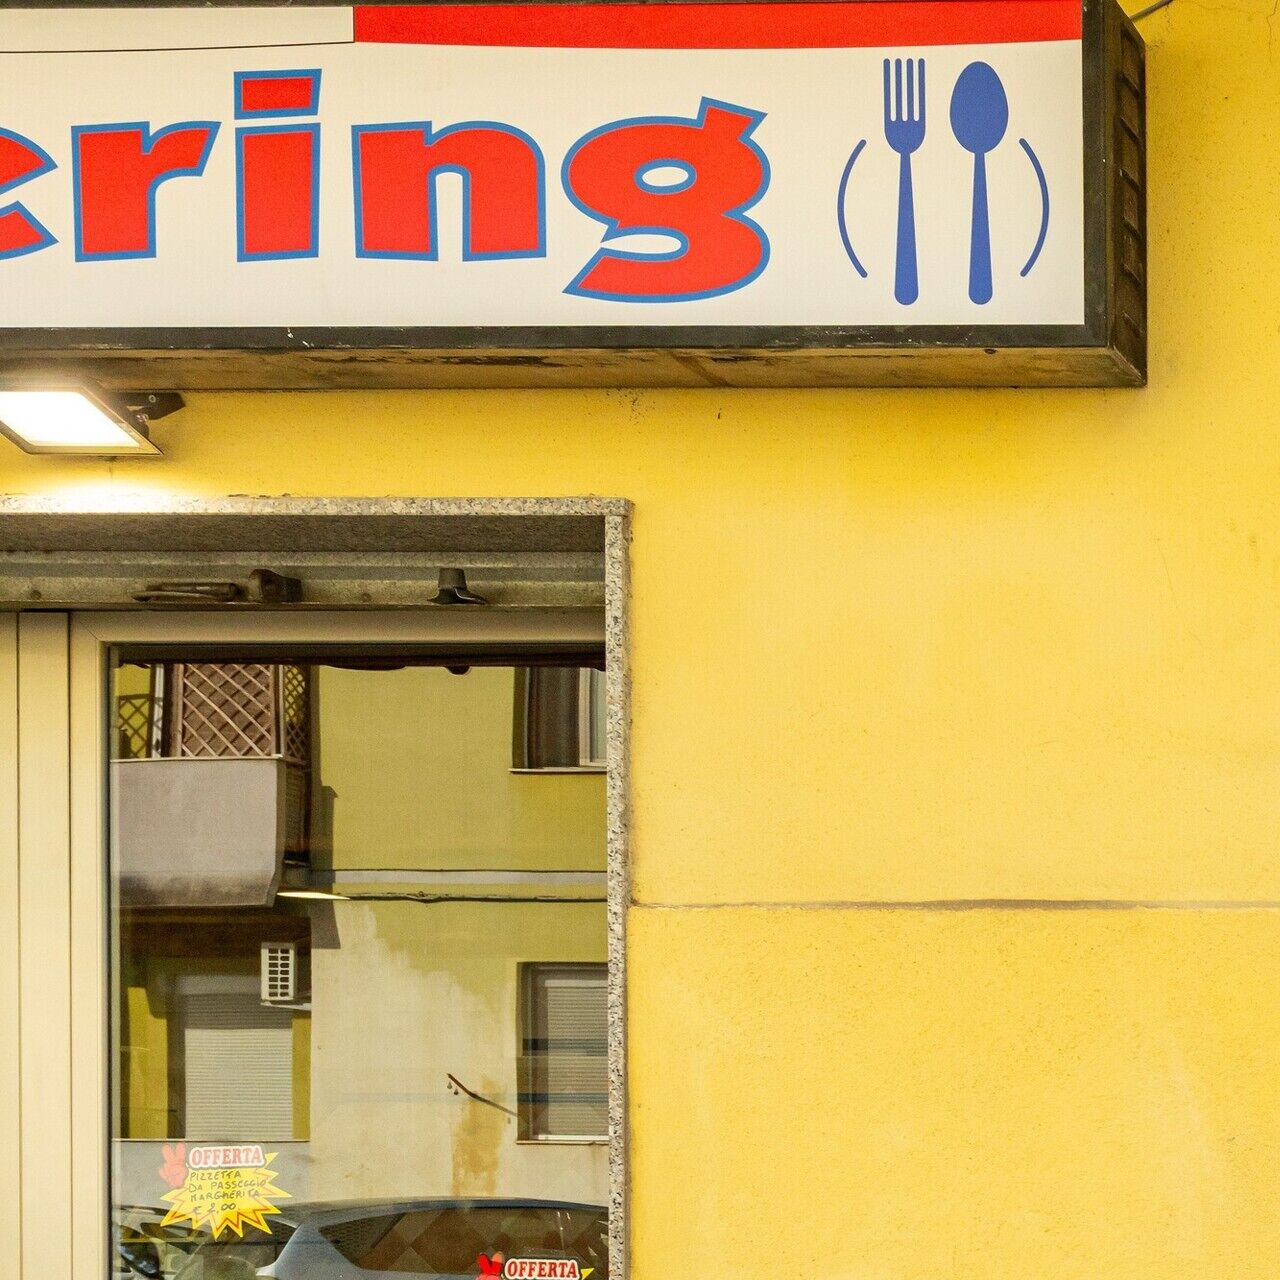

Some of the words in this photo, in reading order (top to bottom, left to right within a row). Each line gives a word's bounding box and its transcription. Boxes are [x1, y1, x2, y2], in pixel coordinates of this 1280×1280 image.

[192, 1147, 263, 1166] OFFERTA
[190, 1170, 242, 1182] PIZZETTA
[188, 1183, 203, 1193] DA
[190, 1189, 260, 1202] MARGHERITA
[507, 1260, 578, 1278] OFFERTA
